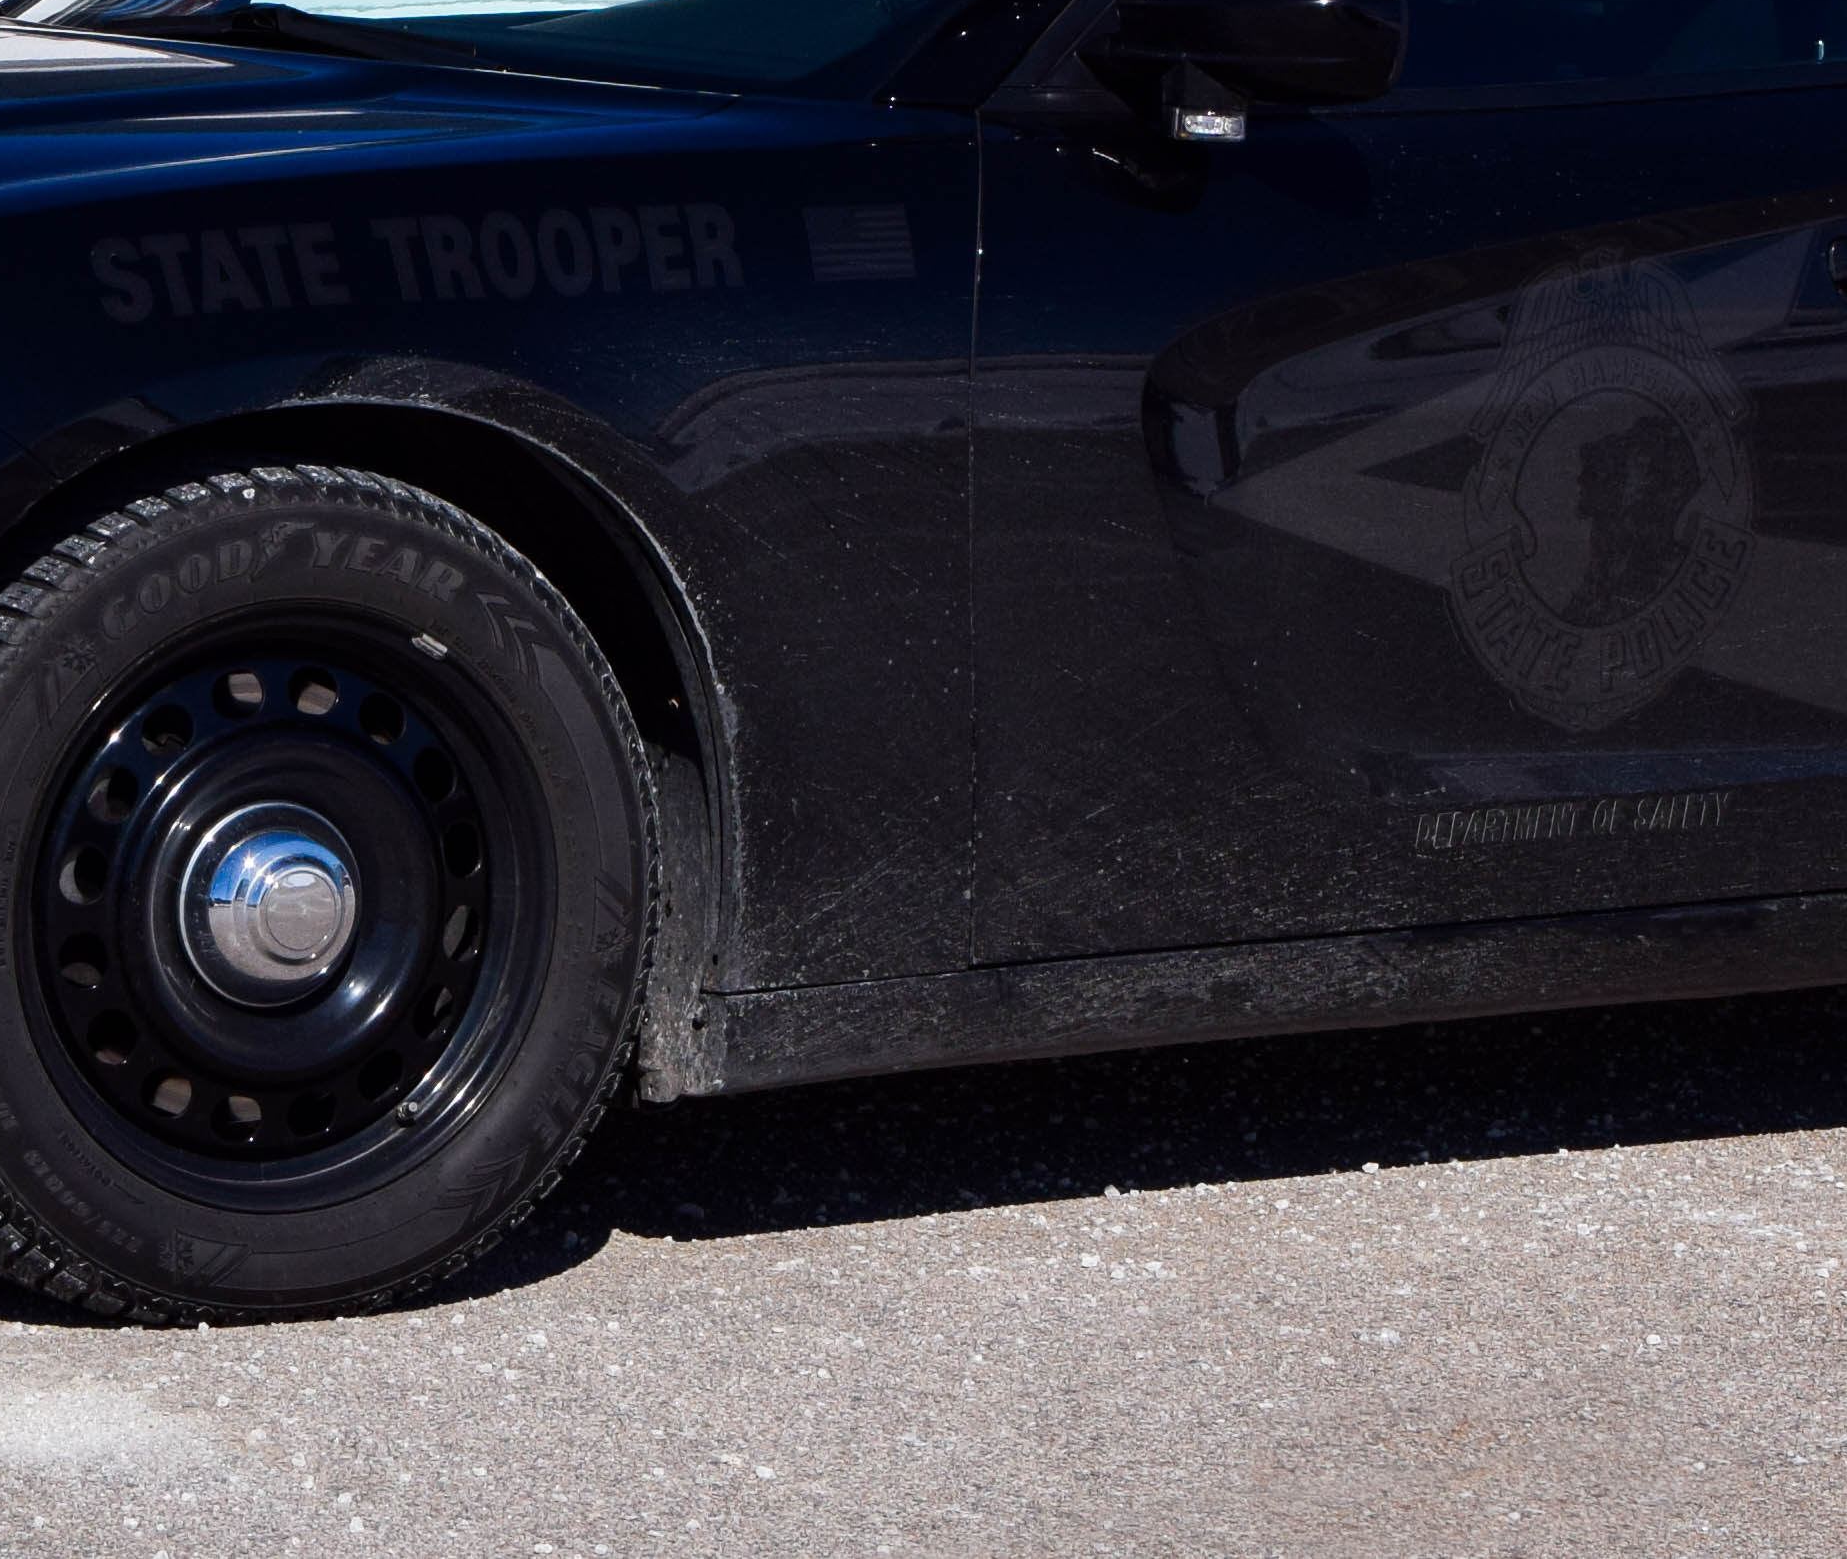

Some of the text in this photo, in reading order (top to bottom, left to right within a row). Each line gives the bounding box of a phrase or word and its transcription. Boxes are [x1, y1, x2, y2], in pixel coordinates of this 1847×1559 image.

[88, 201, 746, 327] STATE TROOPER
[1504, 355, 1708, 448] NEW HAMPSHIRE
[1459, 527, 1749, 695] STATE POLICE
[1413, 792, 1730, 849] DEPARTMENT OF SAFETY
